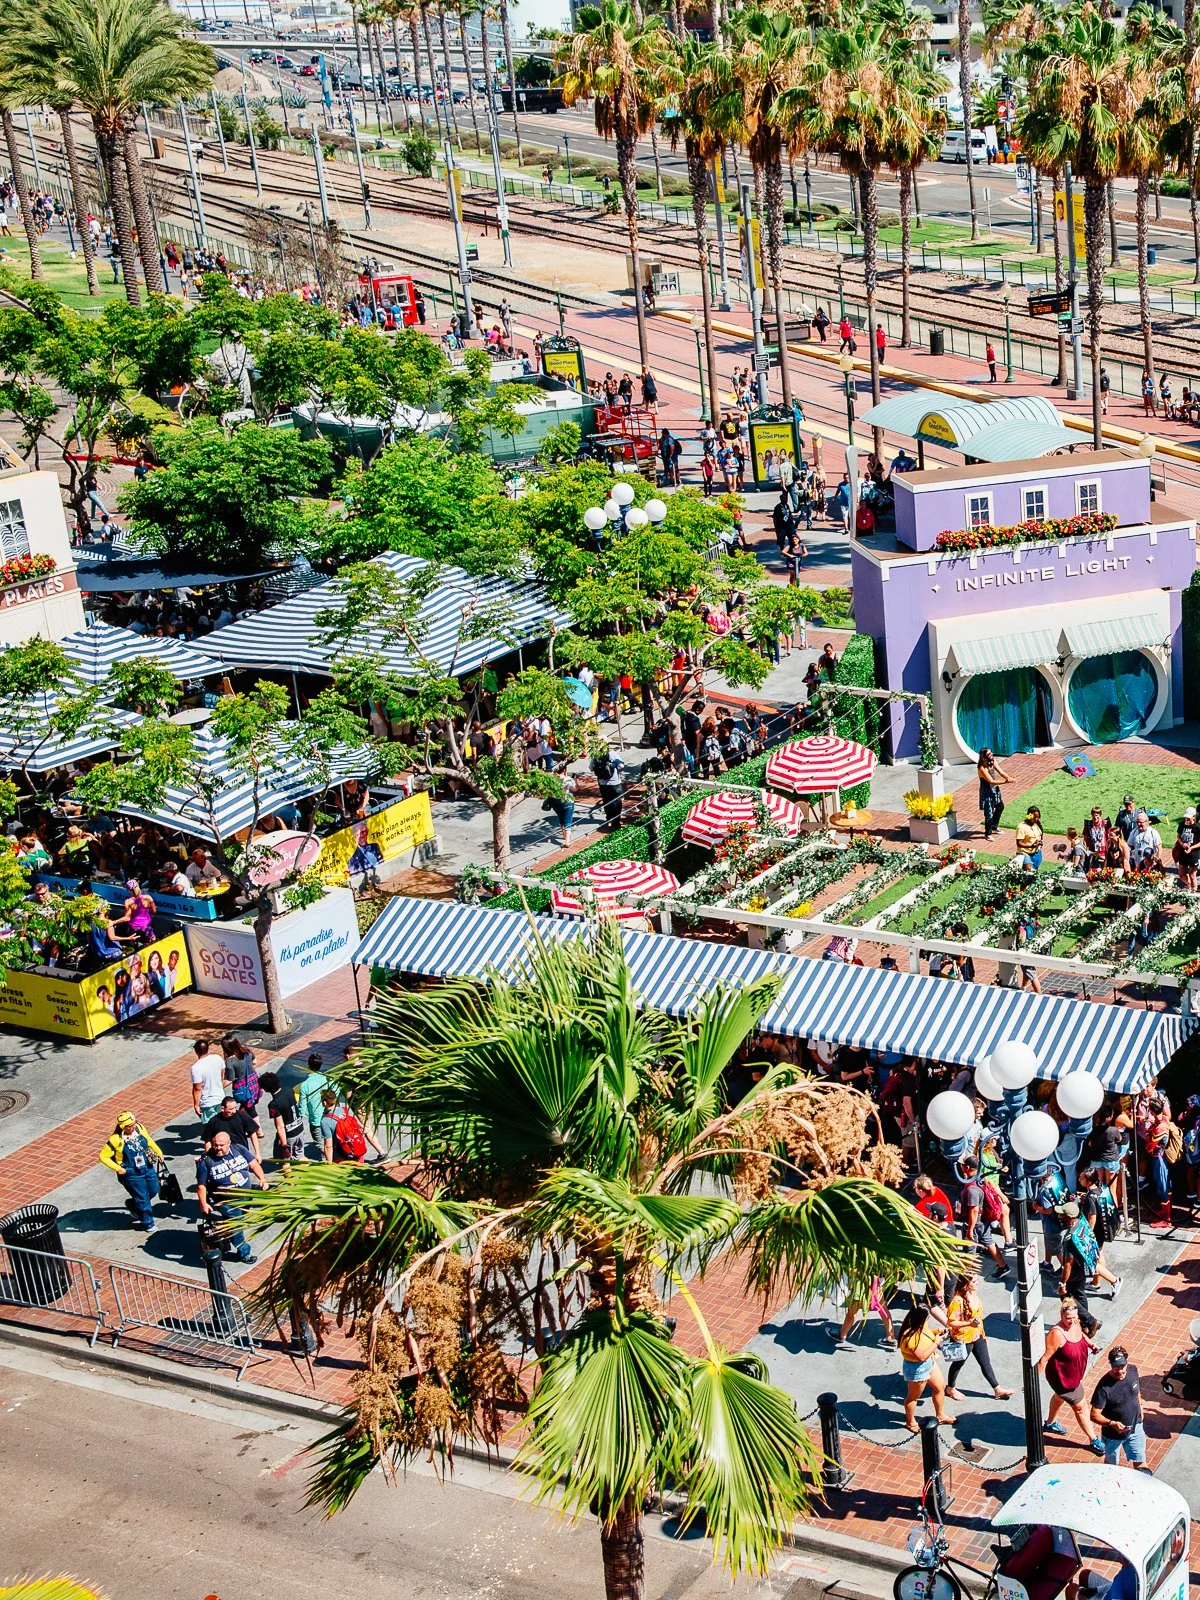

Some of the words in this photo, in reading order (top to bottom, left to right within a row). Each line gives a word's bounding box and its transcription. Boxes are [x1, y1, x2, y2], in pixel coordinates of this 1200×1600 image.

[956, 566, 1056, 592] INFINITE
[1065, 556, 1132, 577] LIGHT
[4, 576, 65, 607] PLATES
[370, 829, 385, 840] The
[385, 822, 399, 834] plan
[399, 810, 422, 825] always
[385, 829, 404, 842] works
[199, 947, 254, 970] GOOD
[280, 945, 292, 963] It's
[293, 928, 333, 960] paradise
[300, 955, 313, 968] on
[321, 931, 350, 960] plate!
[202, 963, 257, 986] PLATES
[46, 994, 78, 1007] Seasons
[64, 1018, 80, 1026] NBC
